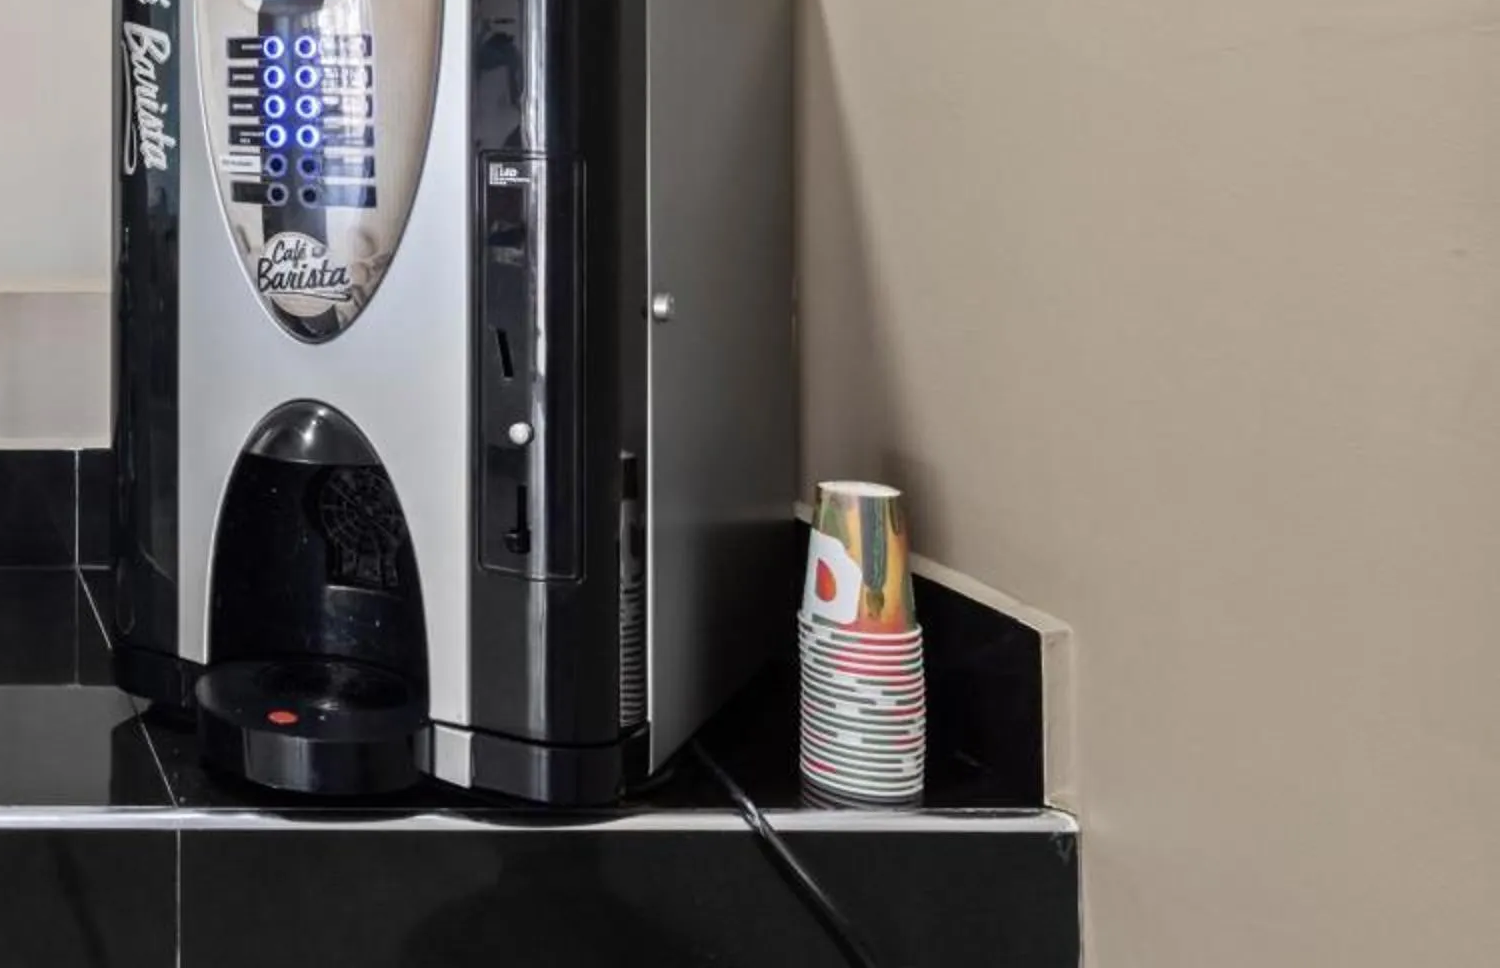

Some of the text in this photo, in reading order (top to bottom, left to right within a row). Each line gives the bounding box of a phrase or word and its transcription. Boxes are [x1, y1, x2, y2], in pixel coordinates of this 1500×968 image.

[121, 21, 176, 172] Barista
[272, 239, 307, 269] Café
[257, 257, 351, 293] Barista
